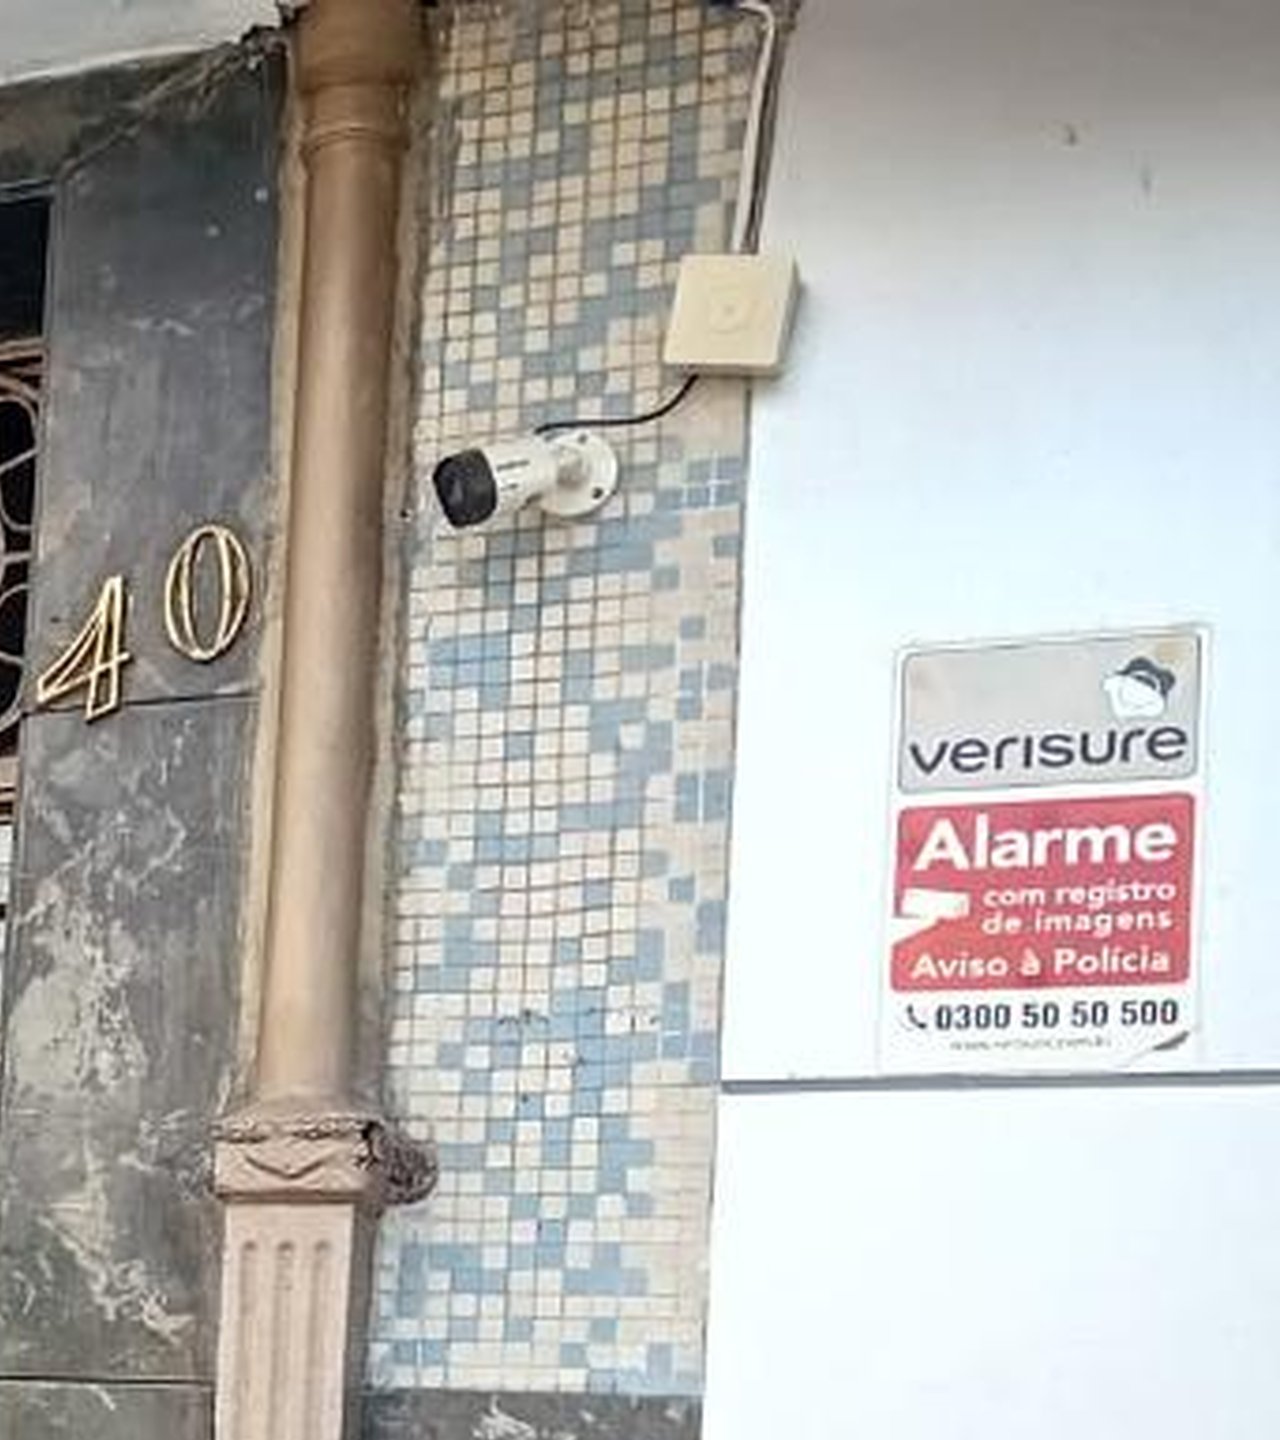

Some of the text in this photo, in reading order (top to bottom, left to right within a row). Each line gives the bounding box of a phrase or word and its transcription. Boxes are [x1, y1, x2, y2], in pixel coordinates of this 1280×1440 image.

[38, 523, 252, 722] 40
[909, 725, 1189, 776] verisure
[913, 813, 1177, 872] Alarme
[983, 879, 1177, 911] com registro
[981, 909, 1173, 938] de imagens
[911, 951, 1009, 979] Aviso
[1053, 945, 1171, 974] Polícia
[935, 998, 1179, 1030] 0300 50 50 500
